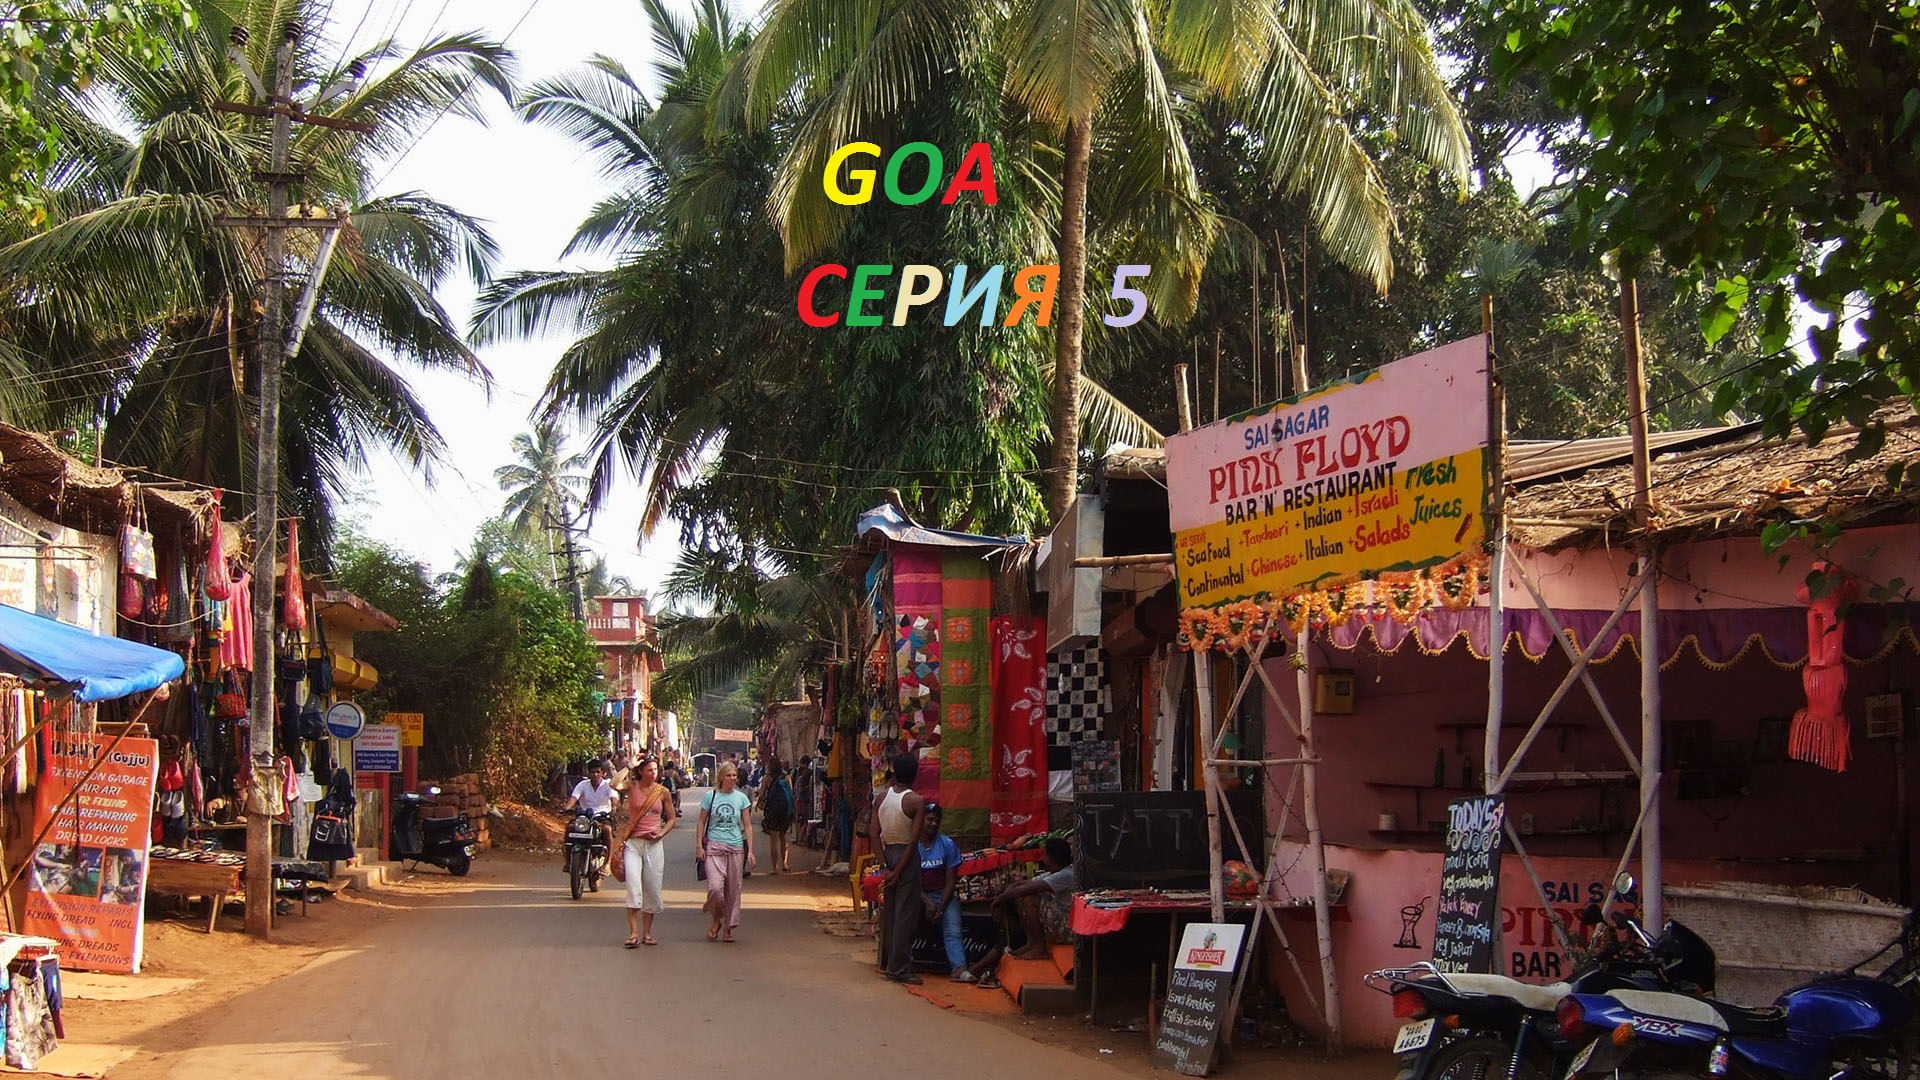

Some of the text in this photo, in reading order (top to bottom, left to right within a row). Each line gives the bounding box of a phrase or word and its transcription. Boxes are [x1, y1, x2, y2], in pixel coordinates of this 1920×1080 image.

[1244, 404, 1330, 450] SAI SAGAR
[1209, 415, 1410, 504] PINK FLOYD
[1225, 498, 1258, 526] BAR
[1284, 461, 1397, 512] RESTAURANT
[1303, 503, 1342, 530] Indian
[1354, 486, 1399, 517] Israeli
[1410, 494, 1463, 526] Juices
[1305, 535, 1343, 560] Italian
[108, 752, 151, 768] (Gujju)
[108, 772, 149, 786] GARAGE
[101, 784, 123, 796] ART
[91, 796, 128, 808] FIXING
[79, 807, 138, 823] REPAIRING
[85, 822, 129, 835] MAKING
[94, 834, 128, 847] LOCKS
[1542, 881, 1579, 903] SAI
[25, 909, 59, 922] FIXING
[61, 914, 96, 927] DREAD
[79, 940, 119, 953] DREADS
[68, 950, 130, 966] EXTENSIONS
[1512, 951, 1561, 978] BAR
